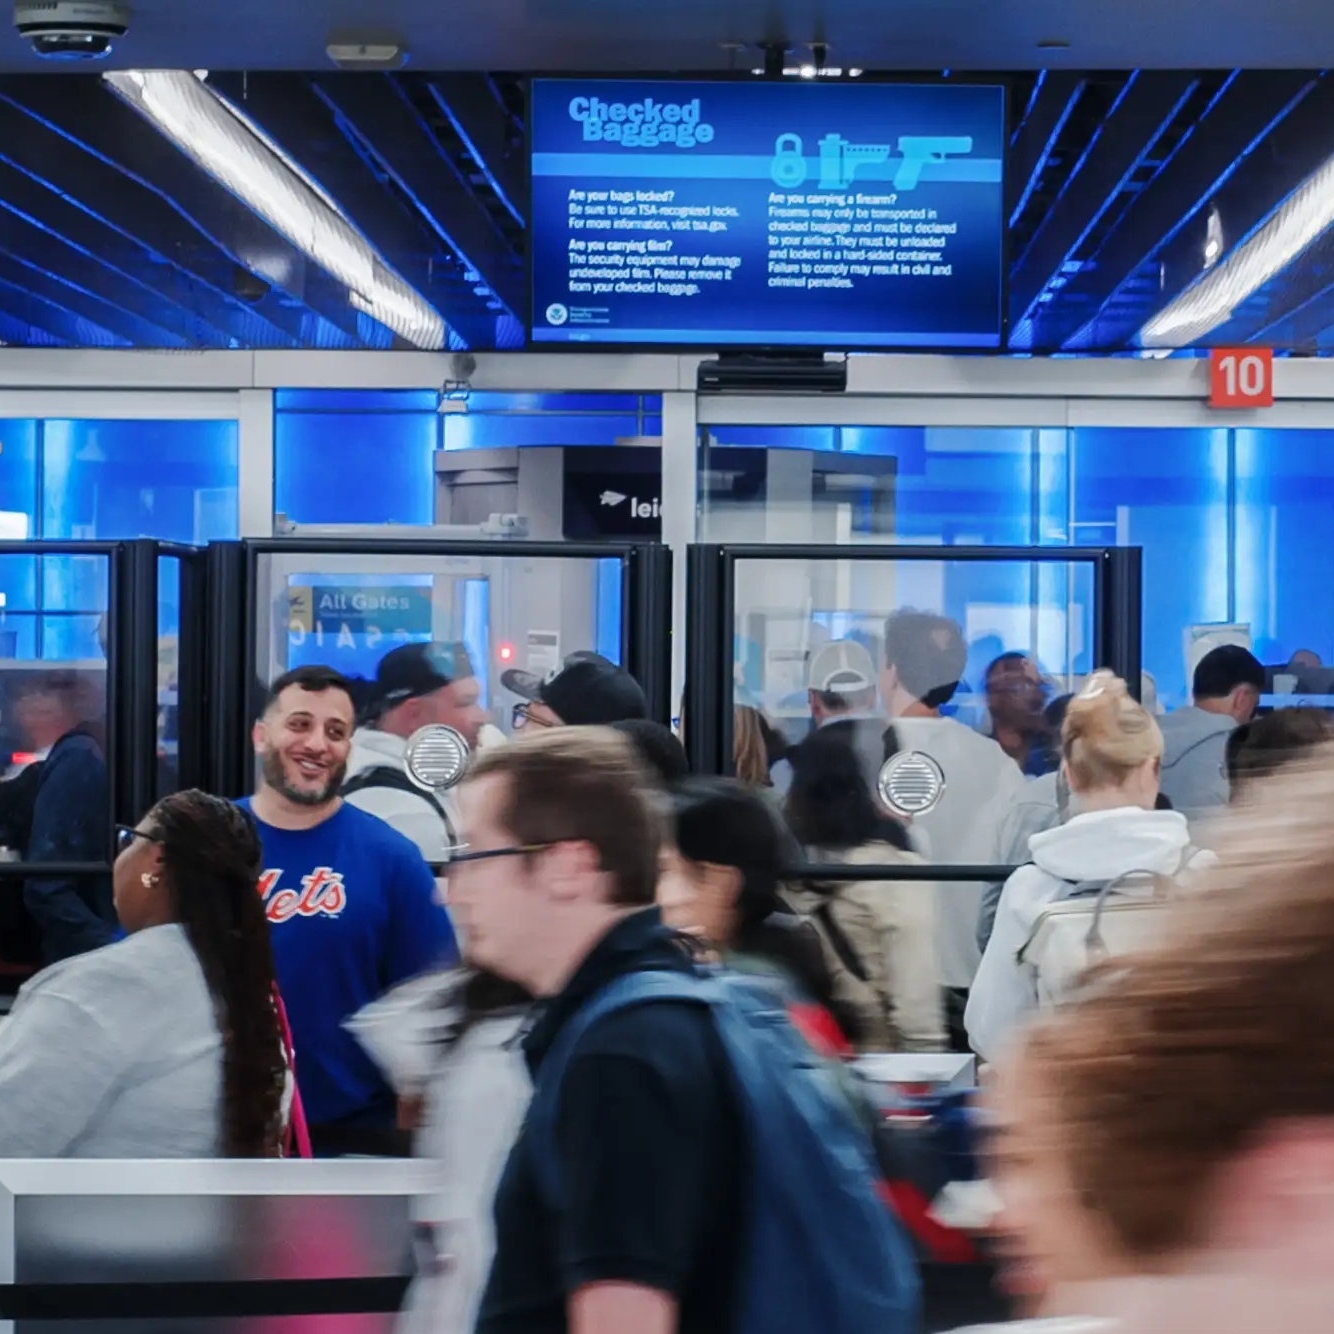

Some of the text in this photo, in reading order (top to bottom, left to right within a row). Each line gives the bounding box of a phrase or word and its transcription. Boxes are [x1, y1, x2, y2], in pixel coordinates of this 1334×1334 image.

[569, 97, 700, 122] Checked
[583, 117, 714, 147] Baggage
[569, 189, 675, 203] Are your bags locked?
[769, 193, 897, 205] Are you carrying a firearm?
[569, 203, 582, 214] Be
[585, 205, 605, 214] sure
[607, 204, 617, 215] to
[619, 206, 636, 215] use
[769, 207, 937, 220] Firearms may only be transported in
[569, 217, 585, 228] For
[586, 219, 611, 229] more
[672, 220, 690, 230] visit
[769, 221, 957, 234] checked baggage and must be declared
[569, 239, 673, 253] Are you carrying film?
[769, 235, 945, 248] to your airline. They must be unloaded
[569, 253, 741, 269] The security equipment may damage
[769, 250, 942, 261] and locked in a hard-sided container.
[569, 268, 732, 280] undeveloped film. Please remove it
[769, 262, 952, 276] Failure to comply may result in civil and
[569, 280, 591, 292] from
[593, 283, 614, 294] your
[615, 282, 655, 292] checked
[768, 277, 853, 289] criminal penalties.
[1219, 356, 1264, 396] 10
[319, 592, 410, 610] All Gates
